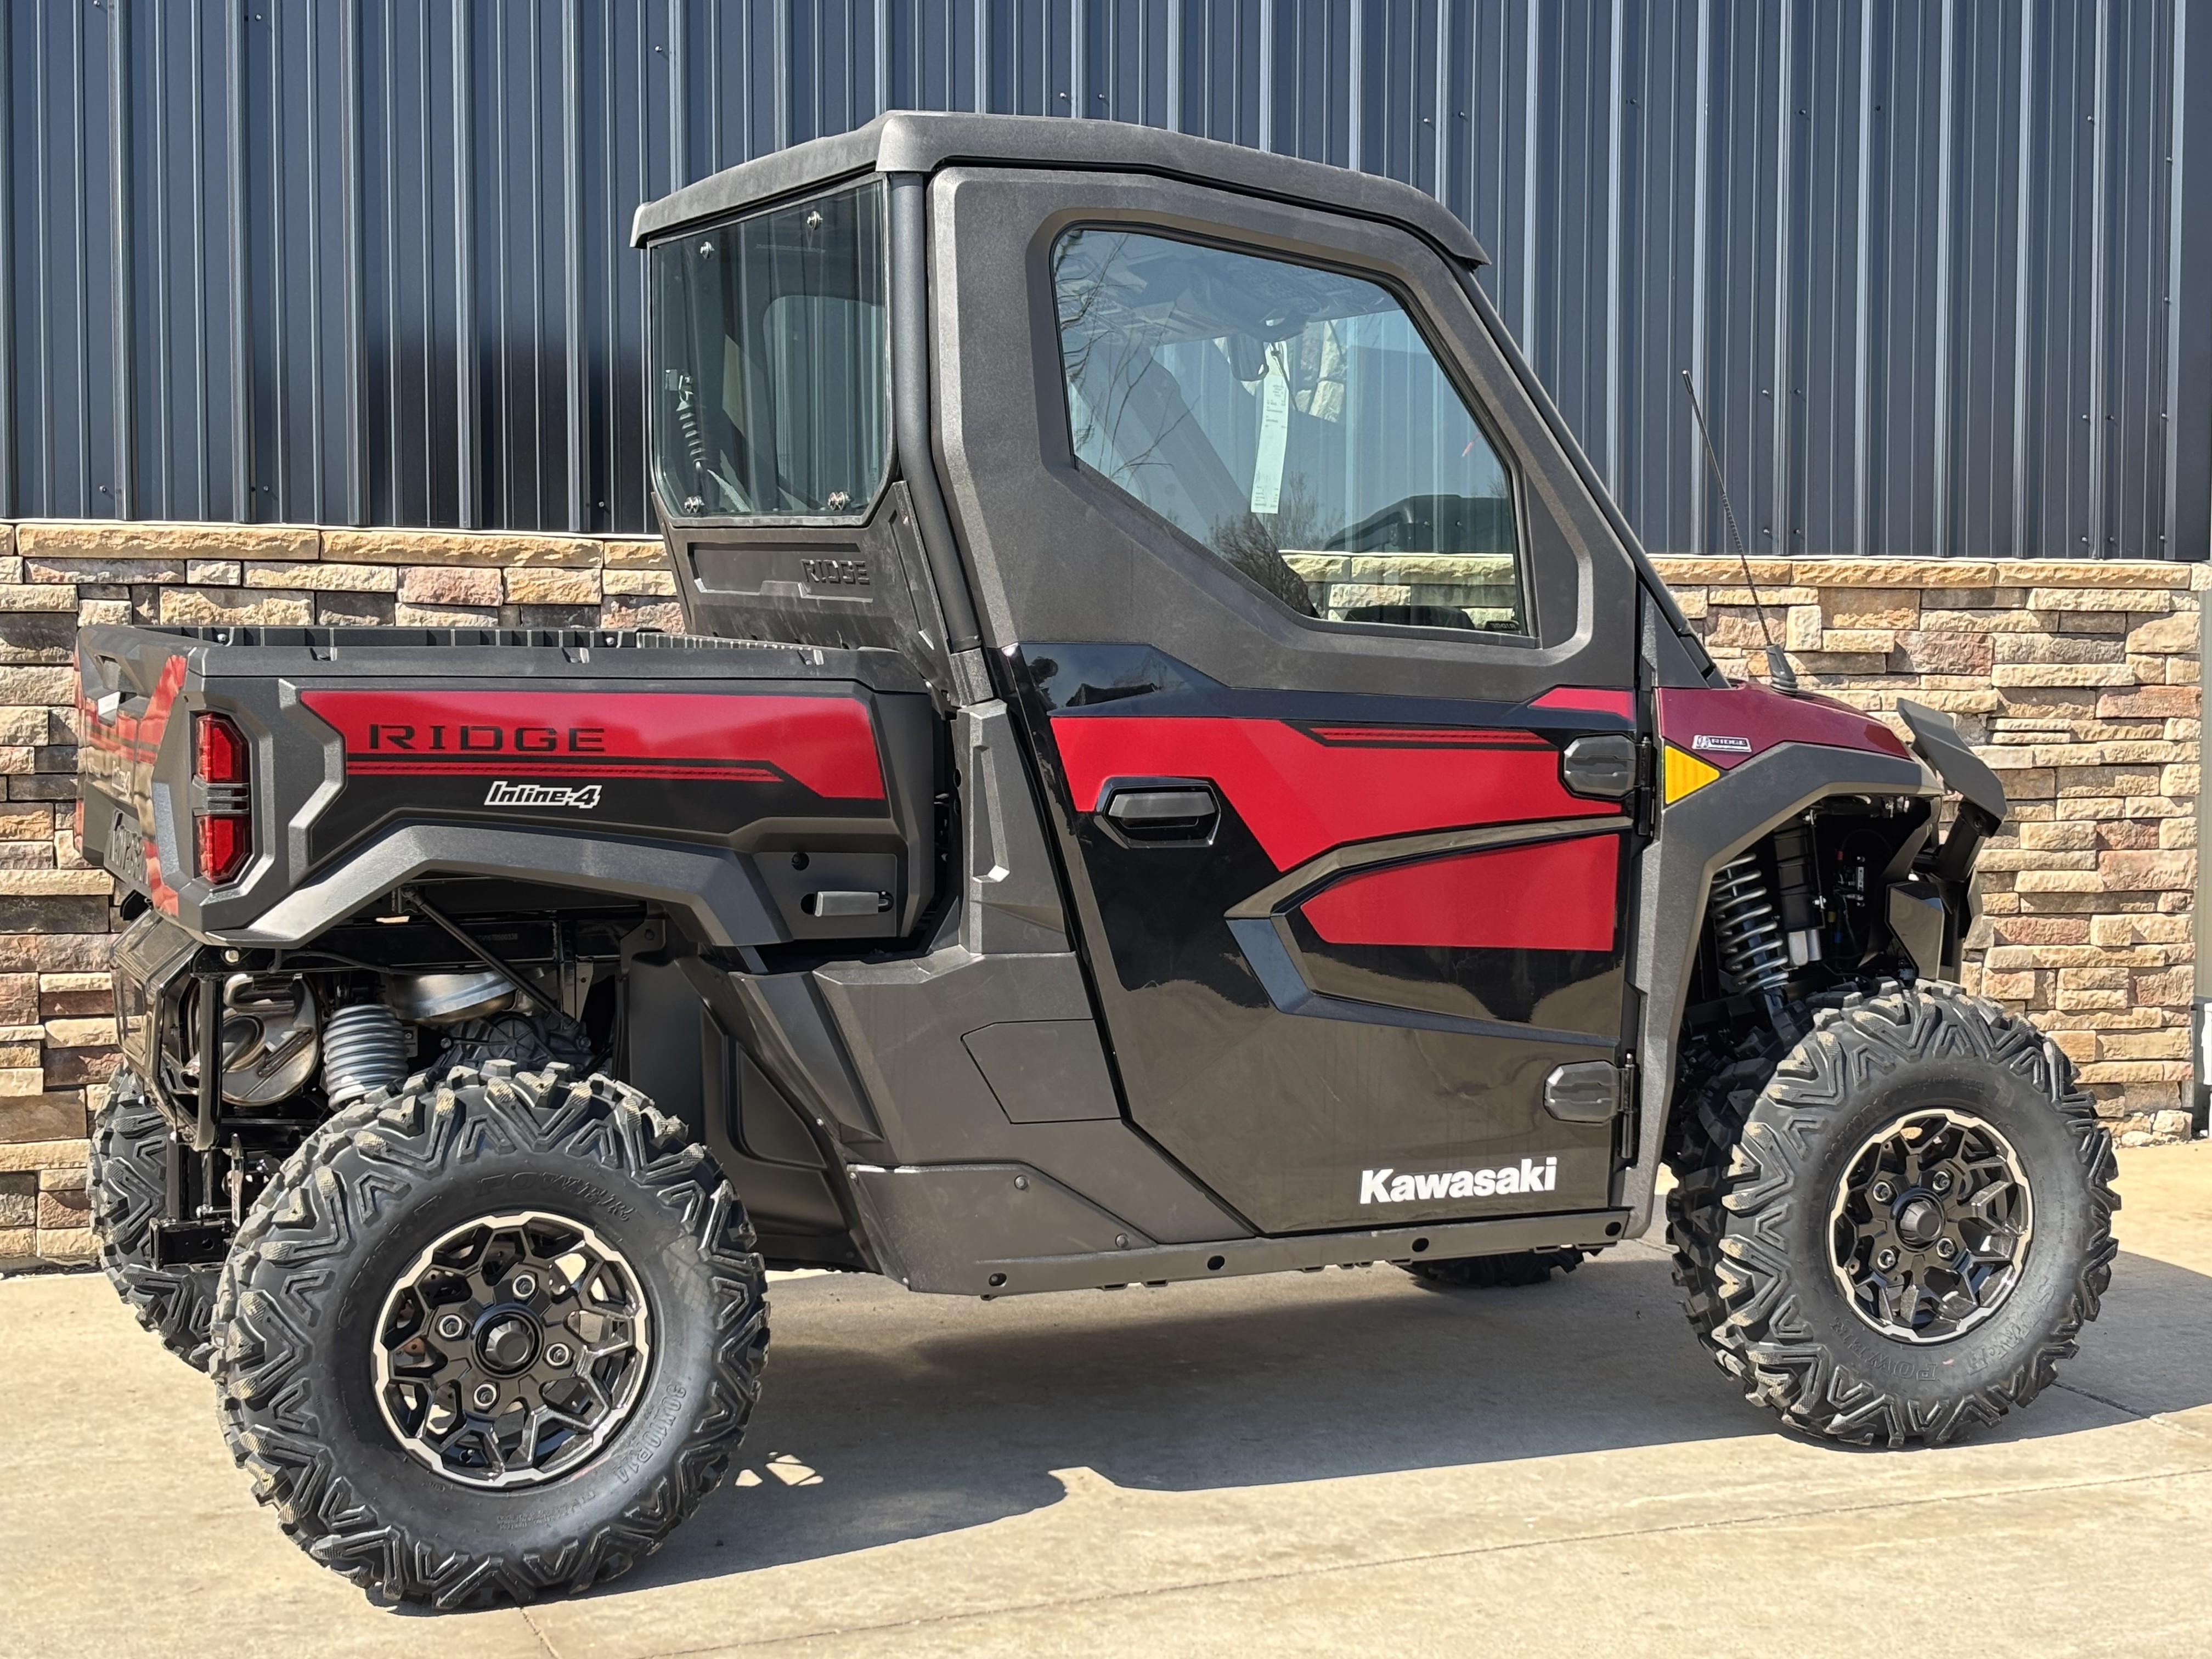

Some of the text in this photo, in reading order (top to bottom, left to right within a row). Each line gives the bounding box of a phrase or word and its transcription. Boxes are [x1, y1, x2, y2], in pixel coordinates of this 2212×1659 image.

[800, 559, 871, 585] RIDGE
[369, 724, 605, 753] RIDGE
[1711, 738, 1746, 746] RIDGE
[484, 781, 602, 809] Inline-4
[1359, 1155, 1559, 1205] Kawasaki
